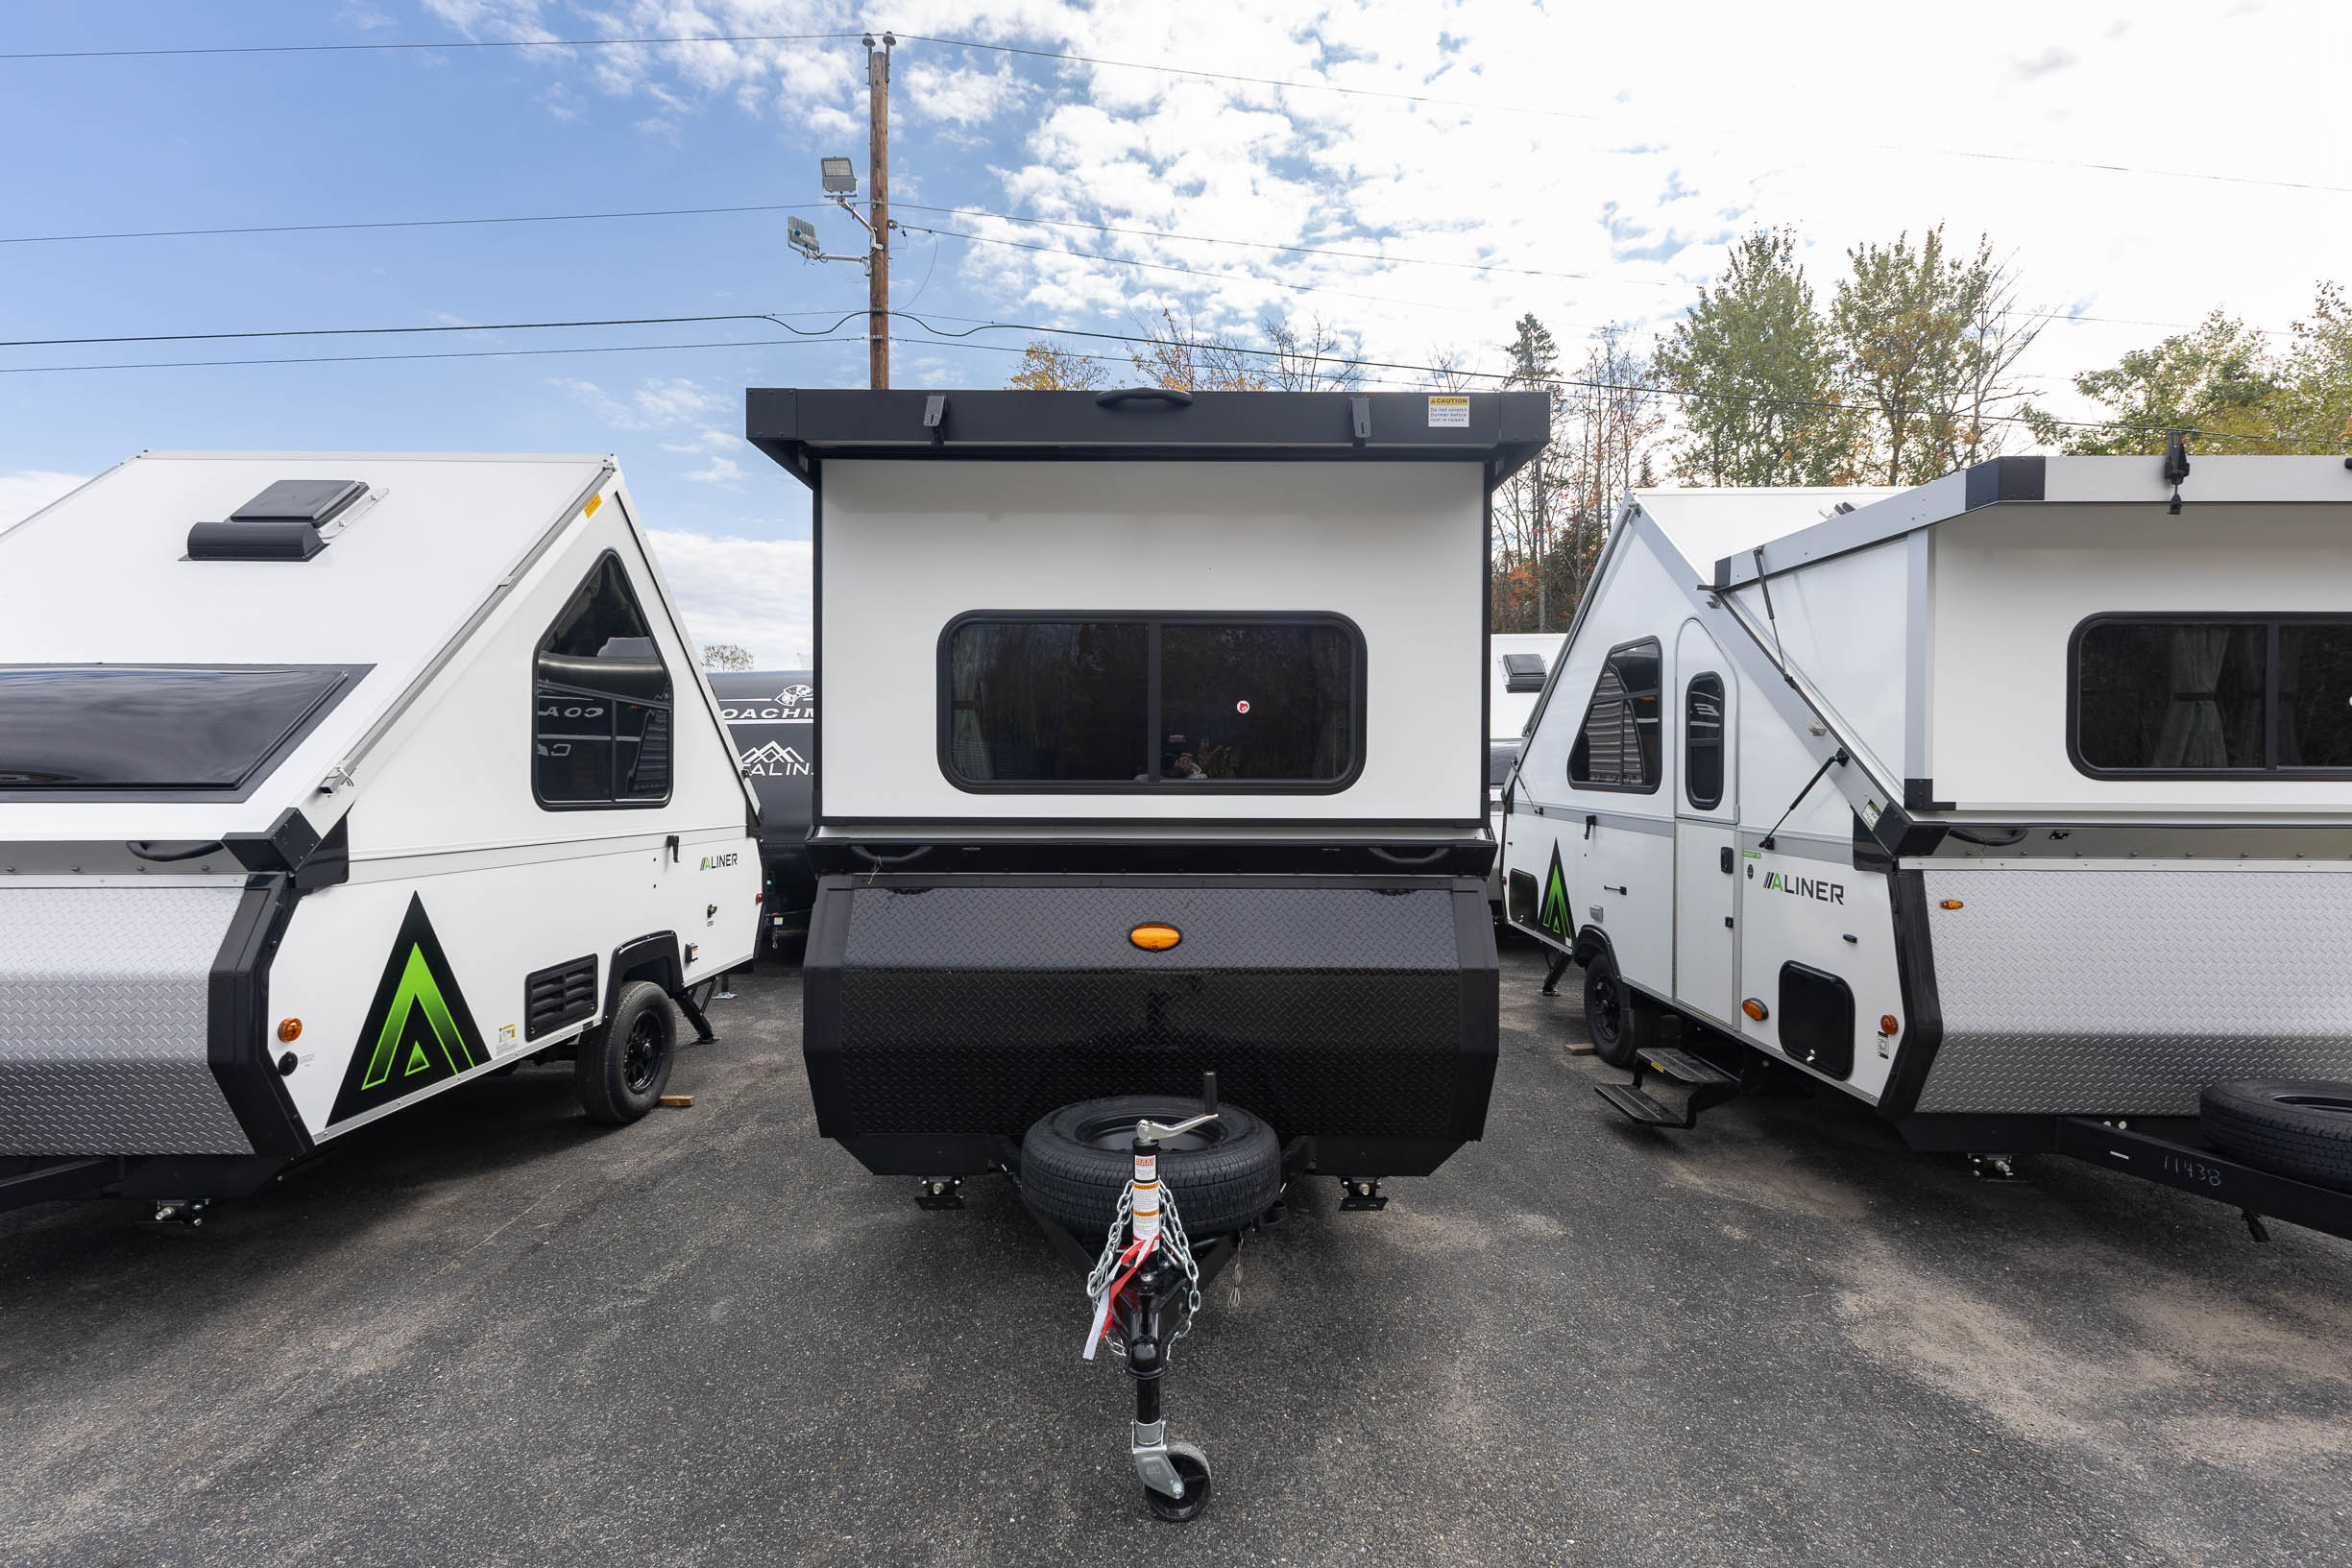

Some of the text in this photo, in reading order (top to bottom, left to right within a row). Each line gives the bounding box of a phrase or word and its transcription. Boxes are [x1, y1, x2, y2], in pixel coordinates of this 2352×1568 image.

[742, 762, 813, 776] ALIN
[703, 853, 738, 870] ALINER
[1770, 872, 1845, 905] ALINER
[2164, 1155, 2221, 1186] 11438
